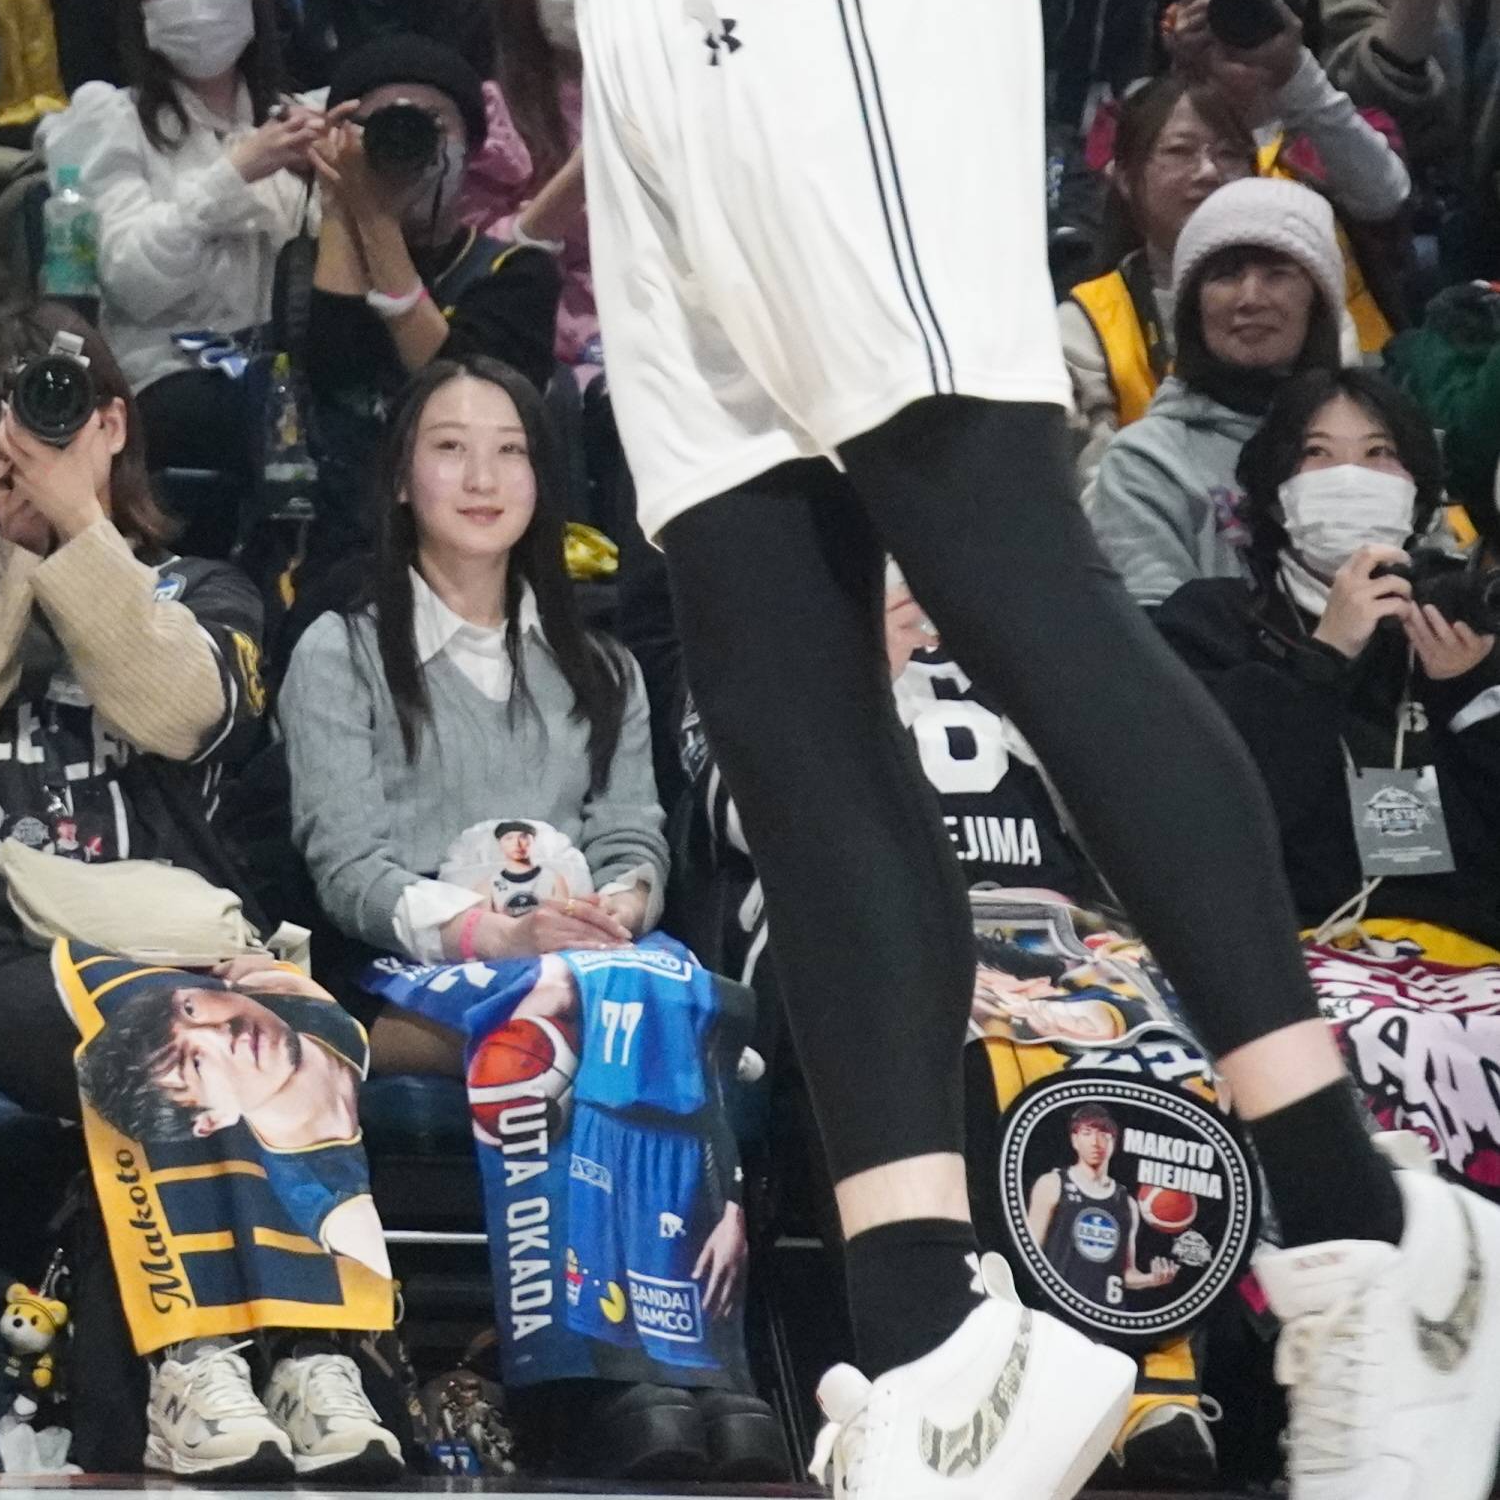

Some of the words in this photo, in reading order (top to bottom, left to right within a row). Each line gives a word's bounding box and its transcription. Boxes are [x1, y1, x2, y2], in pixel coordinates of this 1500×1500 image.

[601, 999, 644, 1067] 77
[1122, 1127, 1216, 1170] MAKOTO
[1137, 1158, 1224, 1201] HIEJIMA
[115, 1149, 192, 1315] Makoto
[505, 1196, 555, 1342] OKADA
[1105, 1274, 1124, 1305] 6
[627, 1281, 691, 1312] BANDAI
